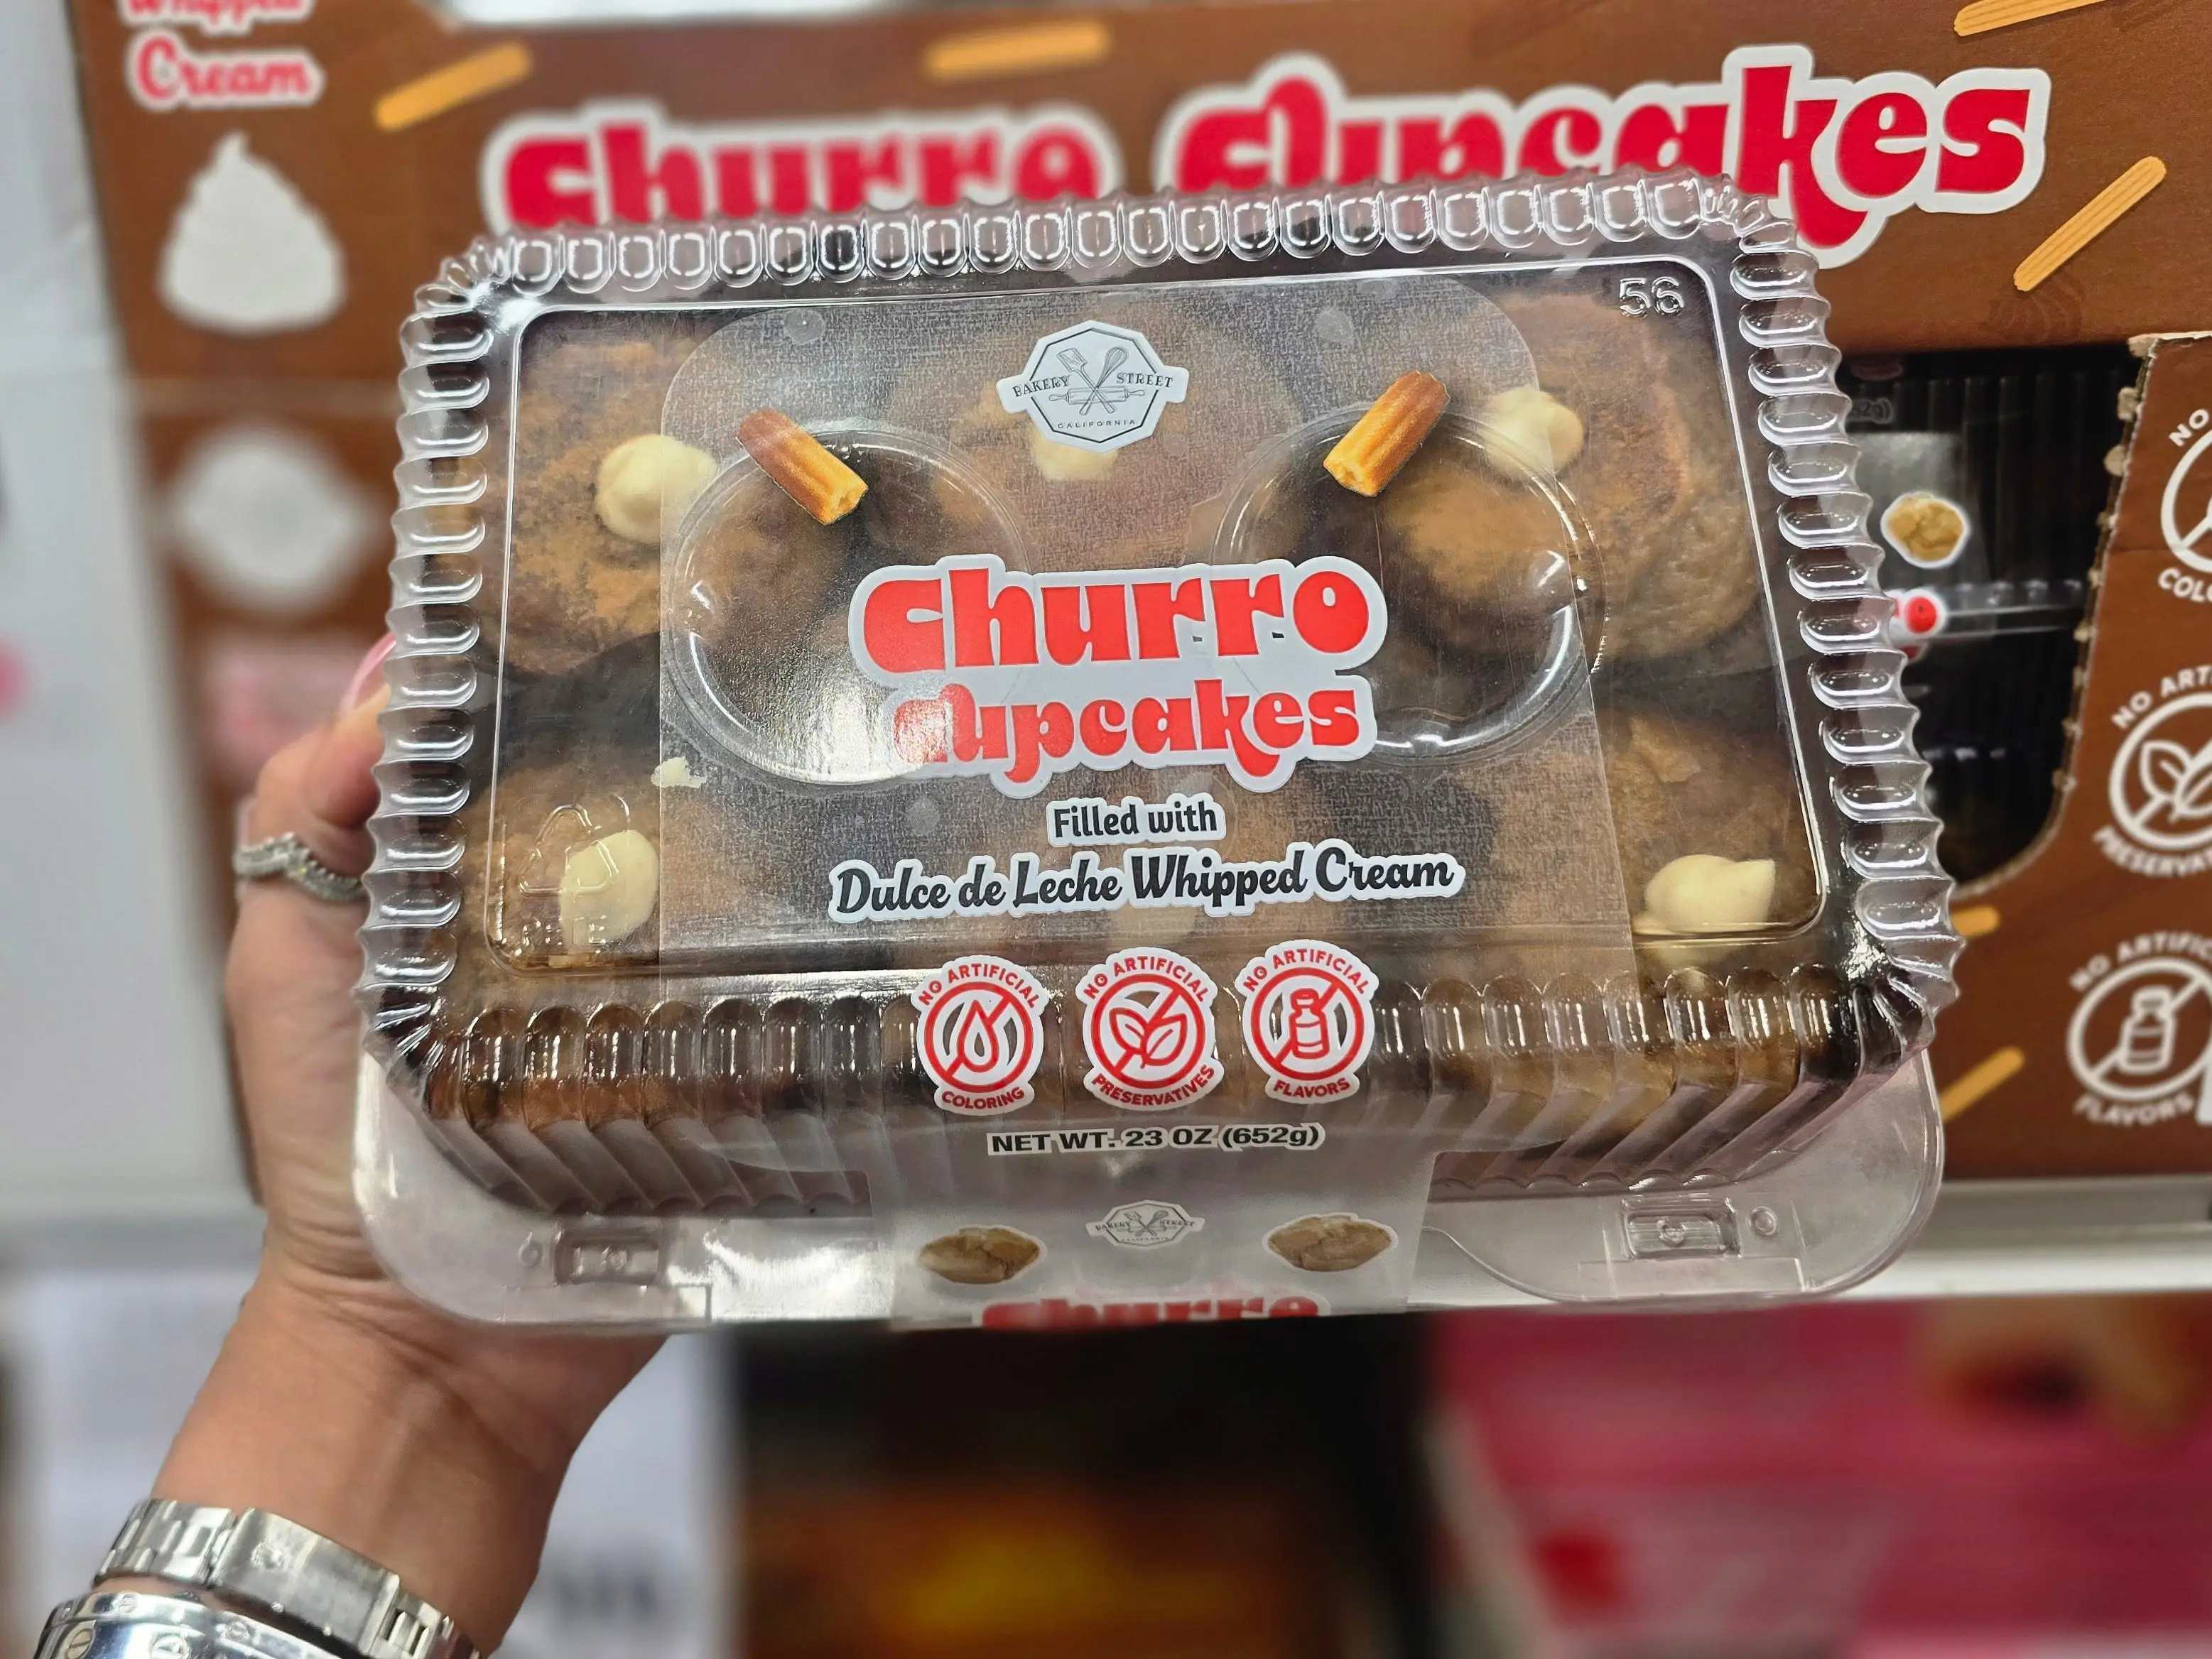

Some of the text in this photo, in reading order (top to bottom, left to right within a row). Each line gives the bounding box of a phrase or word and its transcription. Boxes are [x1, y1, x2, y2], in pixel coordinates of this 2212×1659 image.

[136, 36, 310, 99] Cream
[505, 125, 1098, 229] Churro
[1619, 276, 1684, 317] 56
[1012, 371, 1173, 398] BAKERY STREET
[1057, 419, 1136, 430] CALIFORNIA
[2168, 408, 2210, 447] NO
[864, 569, 1370, 673] Churro
[2111, 691, 2153, 729] NO
[892, 679, 1360, 783] Cupcakes
[1054, 799, 1218, 838] Filled with
[837, 846, 1455, 914] Dulce de Leche Whipped Cream
[918, 962, 1040, 1009] NO ARTIFICIAL
[1083, 955, 1209, 1002] NO ARTIFICIAL
[1242, 948, 1370, 994] NO ARTIFICIAL
[941, 1086, 1025, 1111] COLORING
[1091, 1064, 1215, 1106] PRESERVATIVES
[1272, 1077, 1352, 1099] FLAVORS
[992, 1125, 1319, 1153] NET WT. 23 OZ (652g)
